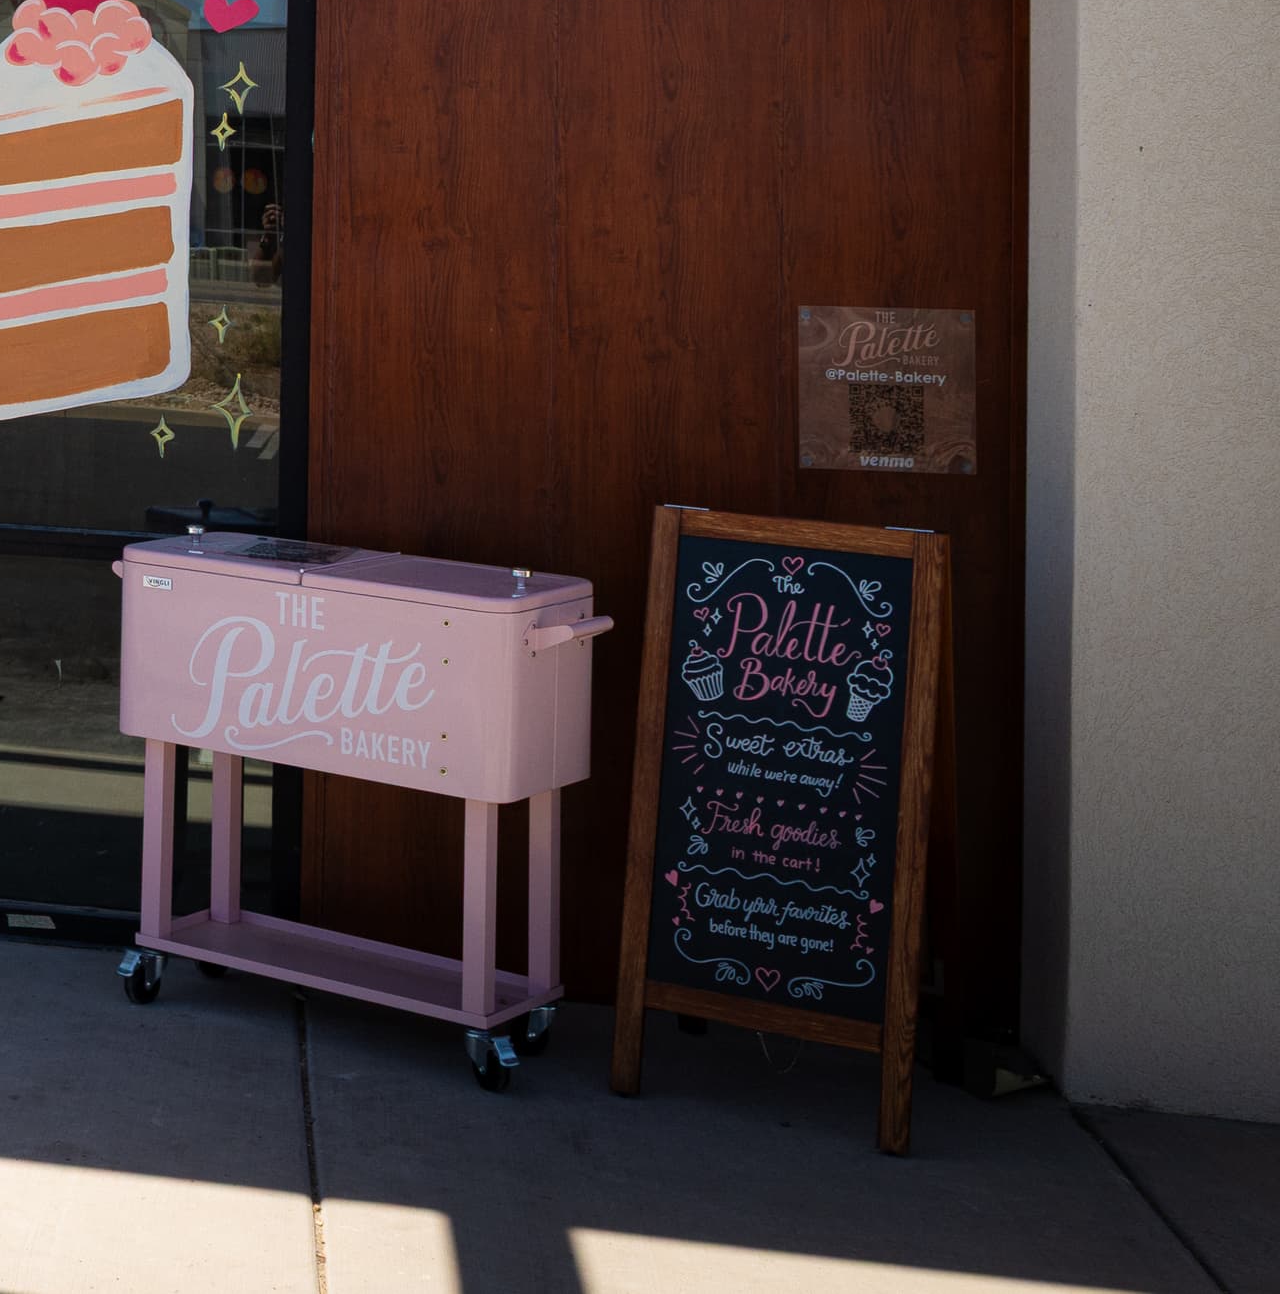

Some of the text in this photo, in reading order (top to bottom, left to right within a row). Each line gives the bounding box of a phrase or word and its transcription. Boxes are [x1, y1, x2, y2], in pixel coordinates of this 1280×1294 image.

[875, 310, 895, 324] THE
[831, 321, 940, 368] Palette
[902, 355, 939, 366] BAKERY
[825, 368, 947, 386] @Palette-Bakery
[860, 456, 914, 468] venmo
[148, 578, 170, 587] VINGLI
[772, 575, 805, 594] The
[274, 591, 325, 631] THE
[716, 592, 862, 666] Palette
[171, 615, 435, 742] Palette
[733, 657, 837, 718] Bakery
[341, 727, 433, 769] BAKERY
[704, 722, 854, 766] Sweet extras
[727, 759, 843, 798] while we're away!
[701, 800, 842, 851] Fresh goodies
[731, 846, 745, 859] in
[752, 850, 777, 865] the
[695, 882, 852, 929] Grab your favorites
[709, 917, 834, 954] before they are gone!
